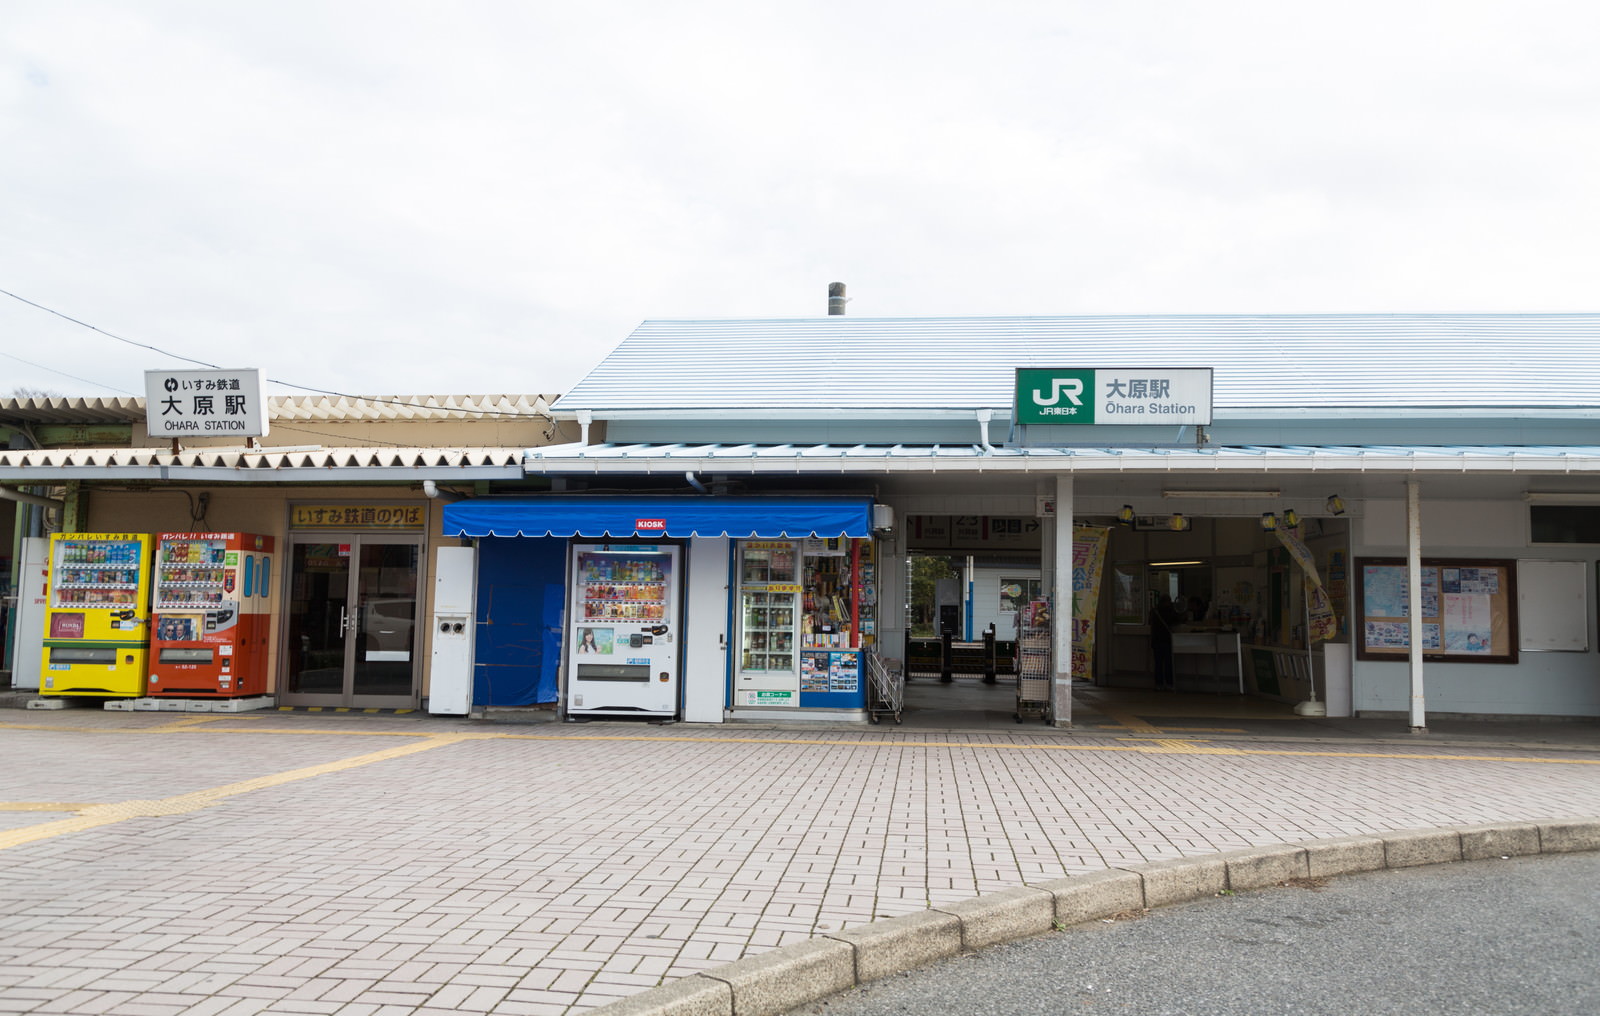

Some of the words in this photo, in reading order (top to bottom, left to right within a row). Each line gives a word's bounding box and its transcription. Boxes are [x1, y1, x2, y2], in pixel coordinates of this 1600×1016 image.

[182, 379, 240, 391] いすみ鉄道
[1106, 378, 1170, 399] 大原駅
[1032, 378, 1084, 406] JR
[161, 395, 247, 415] 大原駅
[1149, 403, 1196, 415] Station
[1039, 407, 1078, 416] JR東日本
[205, 420, 245, 431] STATION
[297, 508, 420, 524] いすみ鉄道のりば
[638, 520, 664, 528] KIOSK
